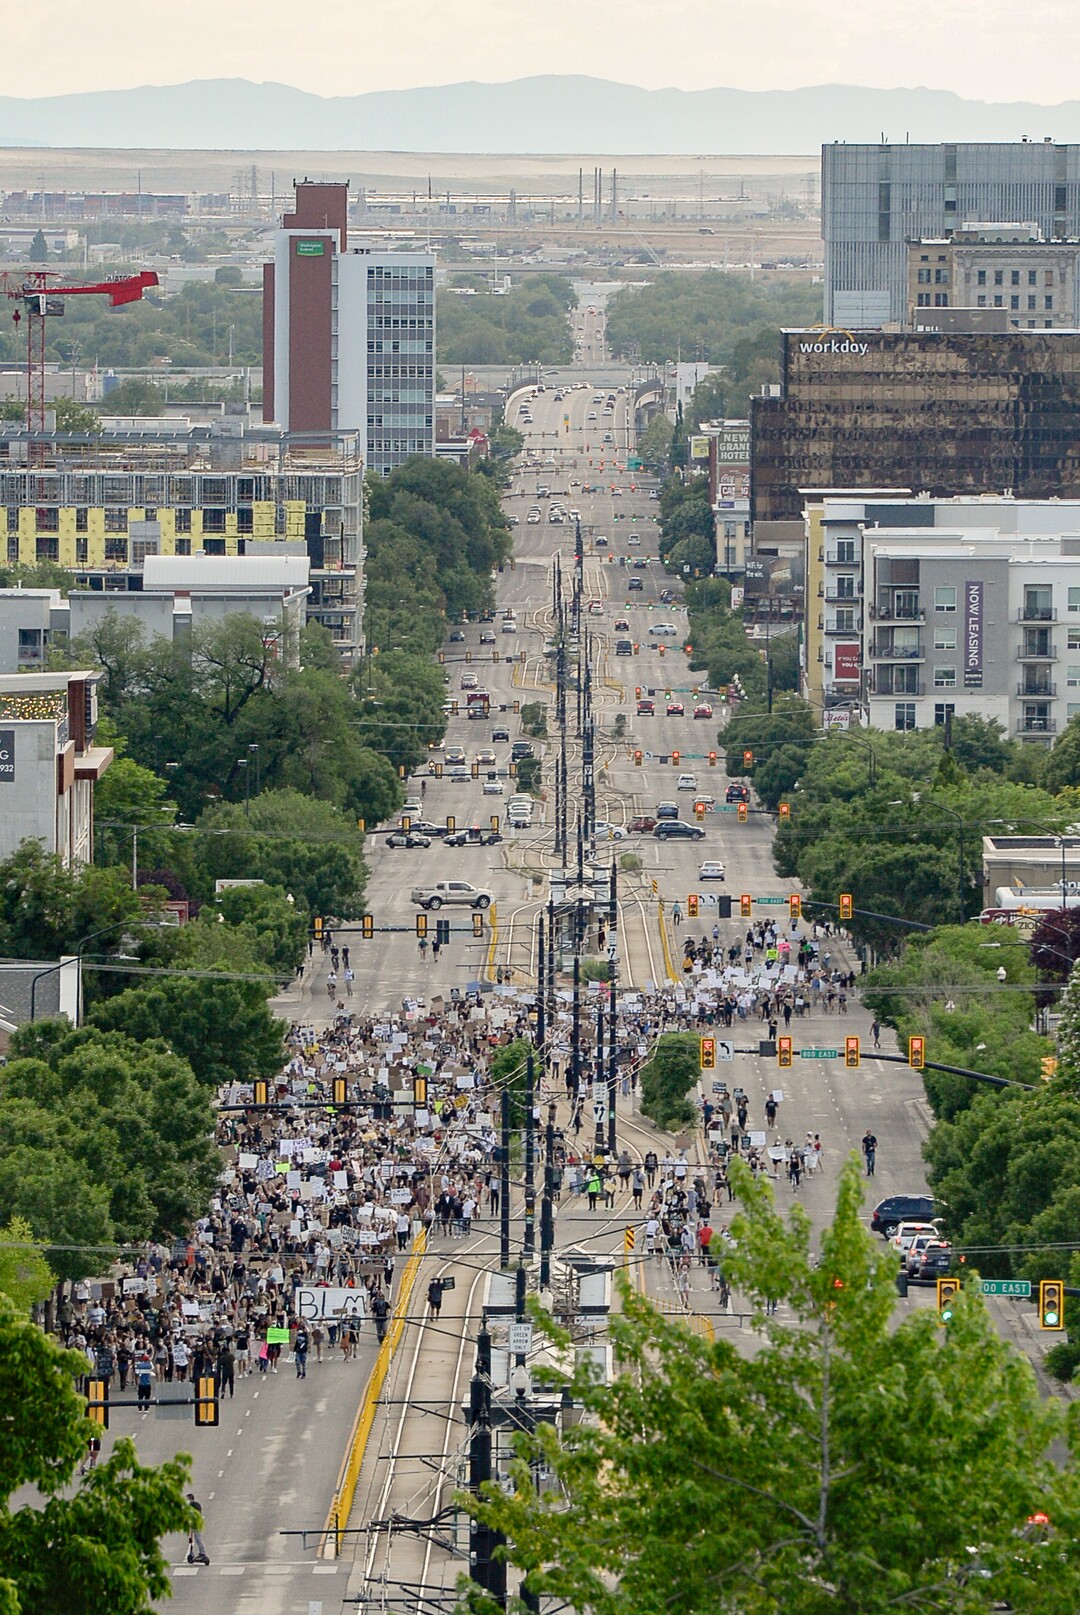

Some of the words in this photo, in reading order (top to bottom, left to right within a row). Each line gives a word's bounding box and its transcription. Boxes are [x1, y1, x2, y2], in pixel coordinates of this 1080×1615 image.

[723, 434, 749, 442] NEW
[969, 585, 979, 615] NOW
[968, 617, 979, 667] LEASING
[803, 1050, 815, 1058] 800
[983, 1284, 996, 1293] 00
[1002, 1284, 1027, 1293] EAST
